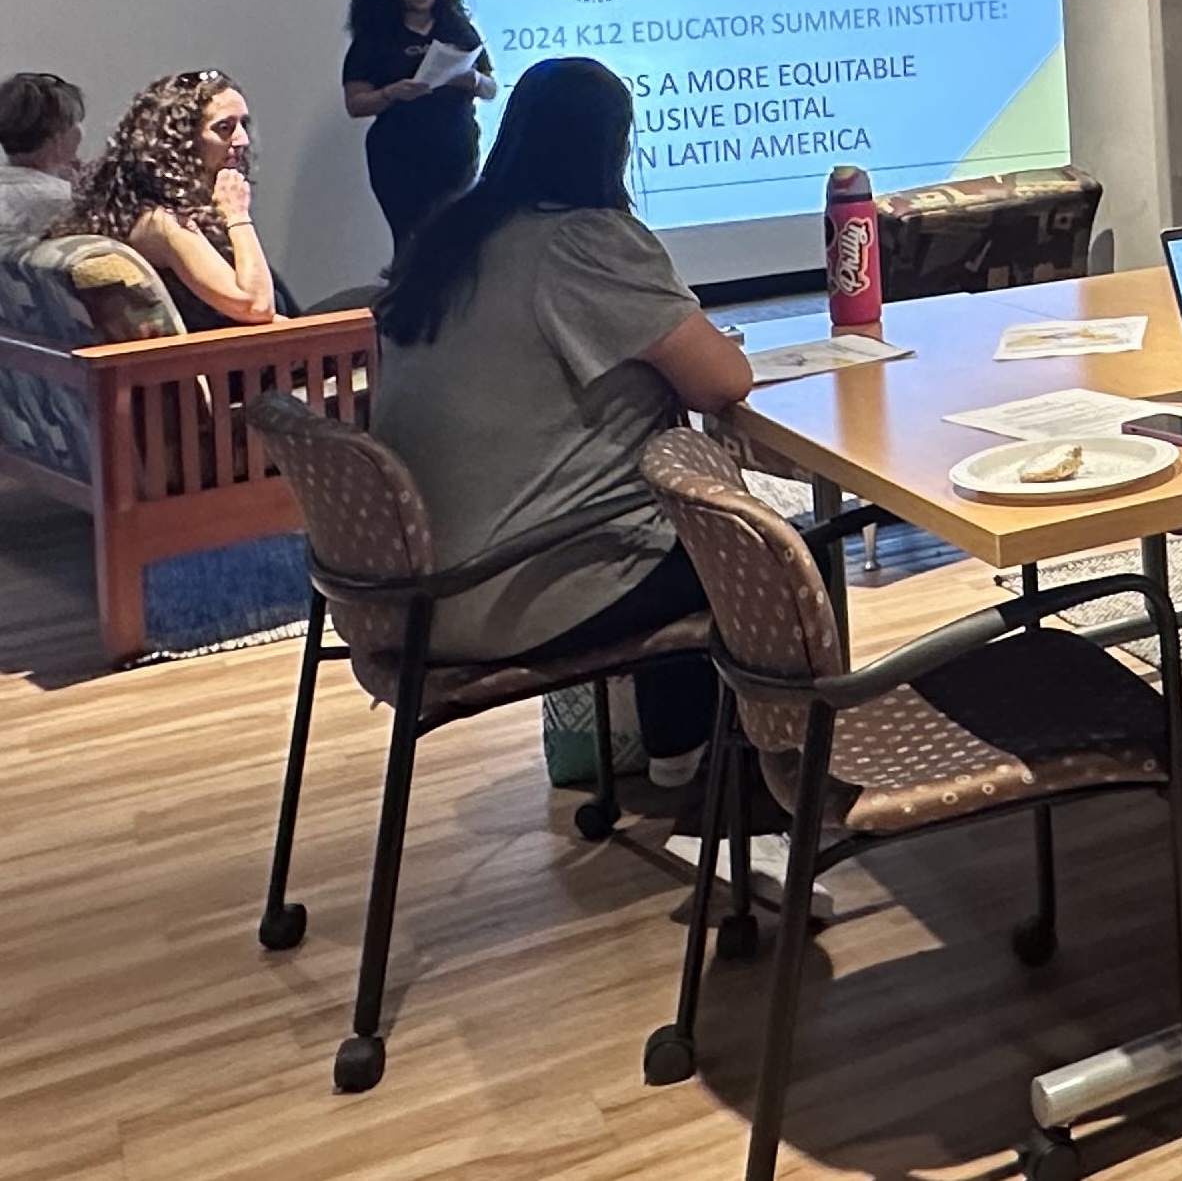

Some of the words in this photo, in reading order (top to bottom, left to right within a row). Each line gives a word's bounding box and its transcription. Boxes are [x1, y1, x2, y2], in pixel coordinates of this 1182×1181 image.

[502, 26, 568, 51] 2024
[576, 22, 624, 47] K12
[632, 15, 766, 43] EDUCATOR
[771, 8, 880, 35] SUMMER
[888, 0, 1009, 26] INSTITUTE:
[659, 72, 680, 97] A
[688, 66, 770, 95] MORE
[779, 55, 918, 88] EQUITABLE
[734, 96, 836, 126] DIGITAL
[668, 138, 742, 168] LATIN
[751, 128, 871, 160] AMERICA
[839, 226, 868, 293] Philly
